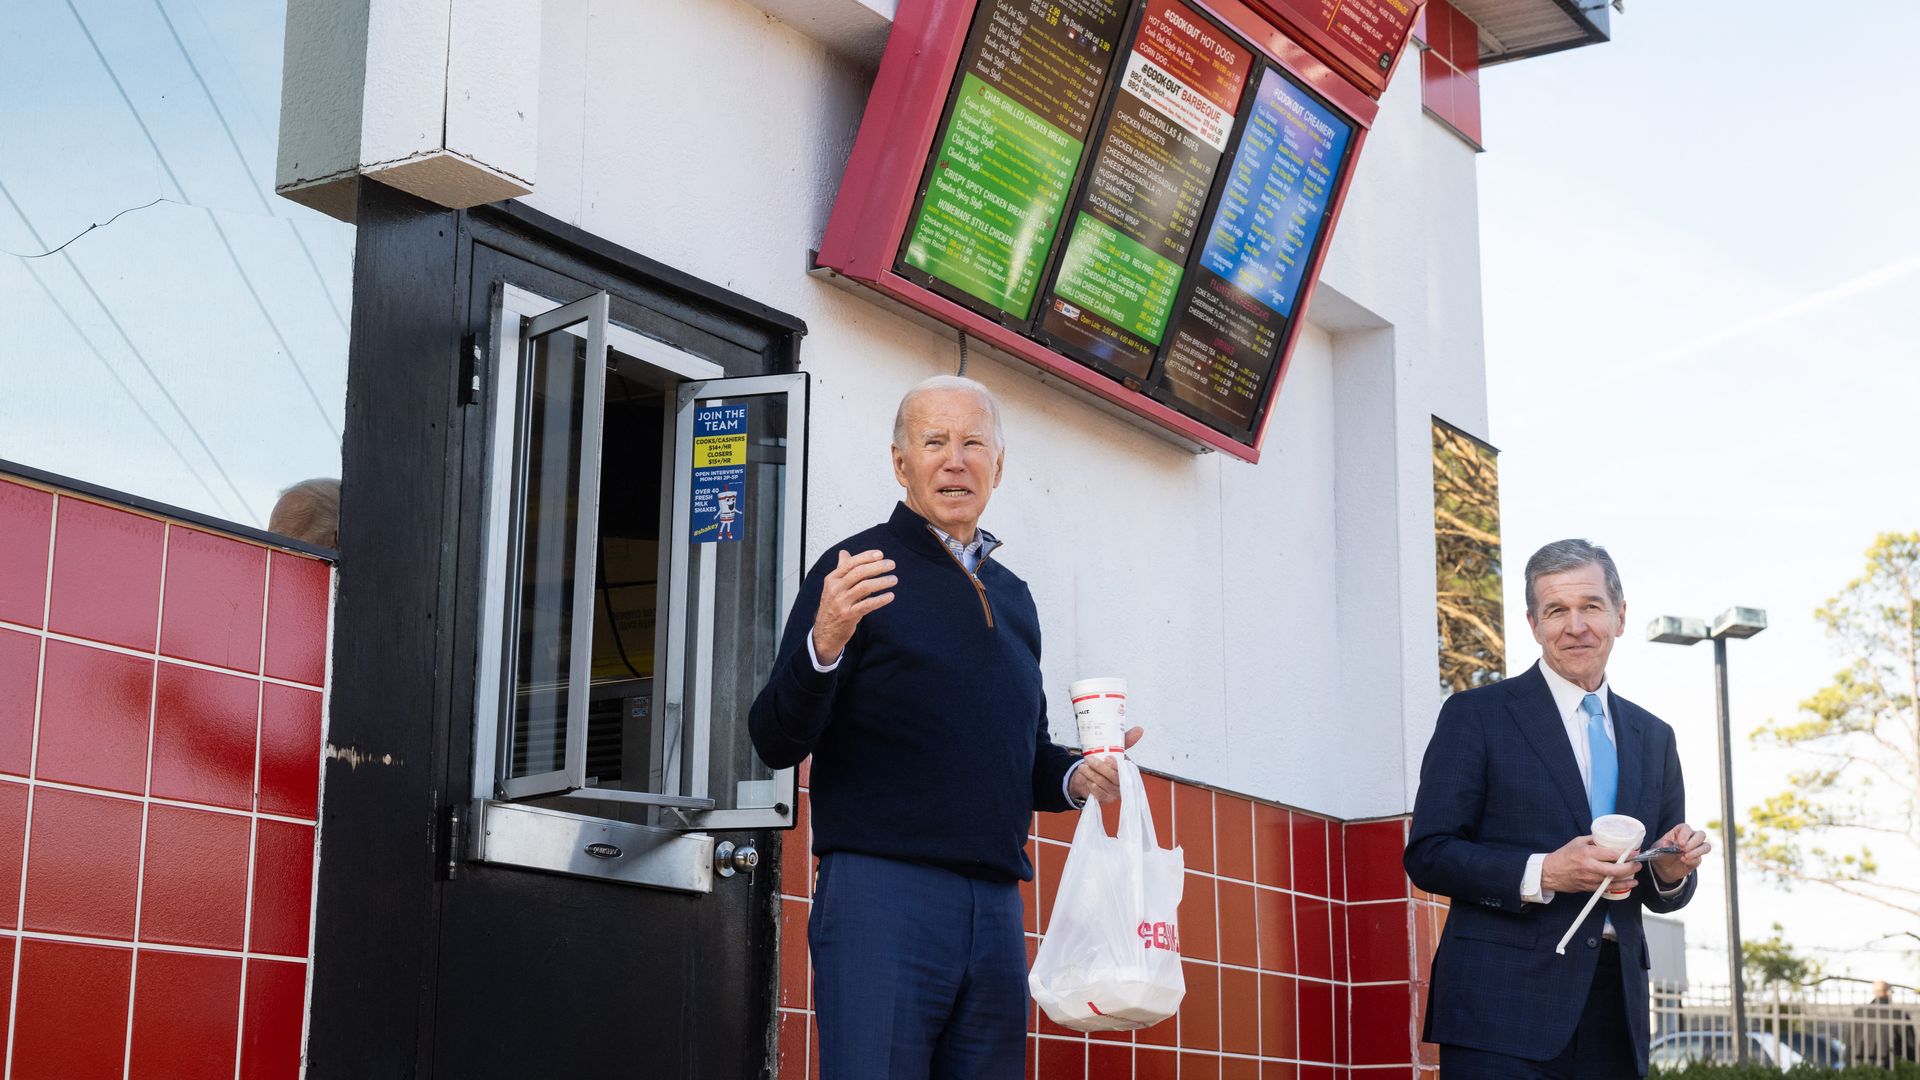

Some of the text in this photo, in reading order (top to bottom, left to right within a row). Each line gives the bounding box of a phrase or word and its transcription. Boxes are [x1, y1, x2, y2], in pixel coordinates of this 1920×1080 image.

[1139, 42, 1155, 56] CORN
[1199, 33, 1215, 51] HOT
[1215, 44, 1235, 64] DOGS
[1142, 78, 1164, 97] Sandwich
[1181, 90, 1220, 122] BARBEQUE
[1024, 115, 1047, 135] CHICKEN
[1047, 129, 1068, 148] BREAST
[1116, 110, 1140, 129] CHICKEN
[1140, 125, 1166, 145] NUGGETS
[1138, 108, 1176, 137] QUESADILLAS
[1182, 135, 1199, 152] SIDES
[1303, 111, 1335, 140] CREAMERY
[1109, 135, 1164, 172] CHICKEN QUESADILLA
[1098, 167, 1135, 193] HUSHPUPPIES
[1102, 156, 1123, 173] CHEESE
[1123, 169, 1155, 191] QUESADILLA
[1105, 145, 1147, 174] CHEESEBURGER
[1147, 170, 1178, 193] QUESADILLA
[943, 168, 965, 186] CRISPY
[965, 180, 982, 195] SPICY
[983, 190, 1007, 209] CHICKEN
[1105, 183, 1132, 203] SANDWICH
[1089, 194, 1107, 208] BACON
[1107, 204, 1124, 218] RANCH
[937, 198, 971, 222] HOMEMADE
[971, 216, 989, 232] STYLE
[988, 226, 1013, 245] CHICKEN
[1118, 275, 1135, 288] CHEESE
[1074, 291, 1094, 306] CHEESE
[698, 409, 745, 421] JOIN THE
[704, 420, 737, 431] TEAM
[696, 436, 745, 445] COOKS/CASHIERS
